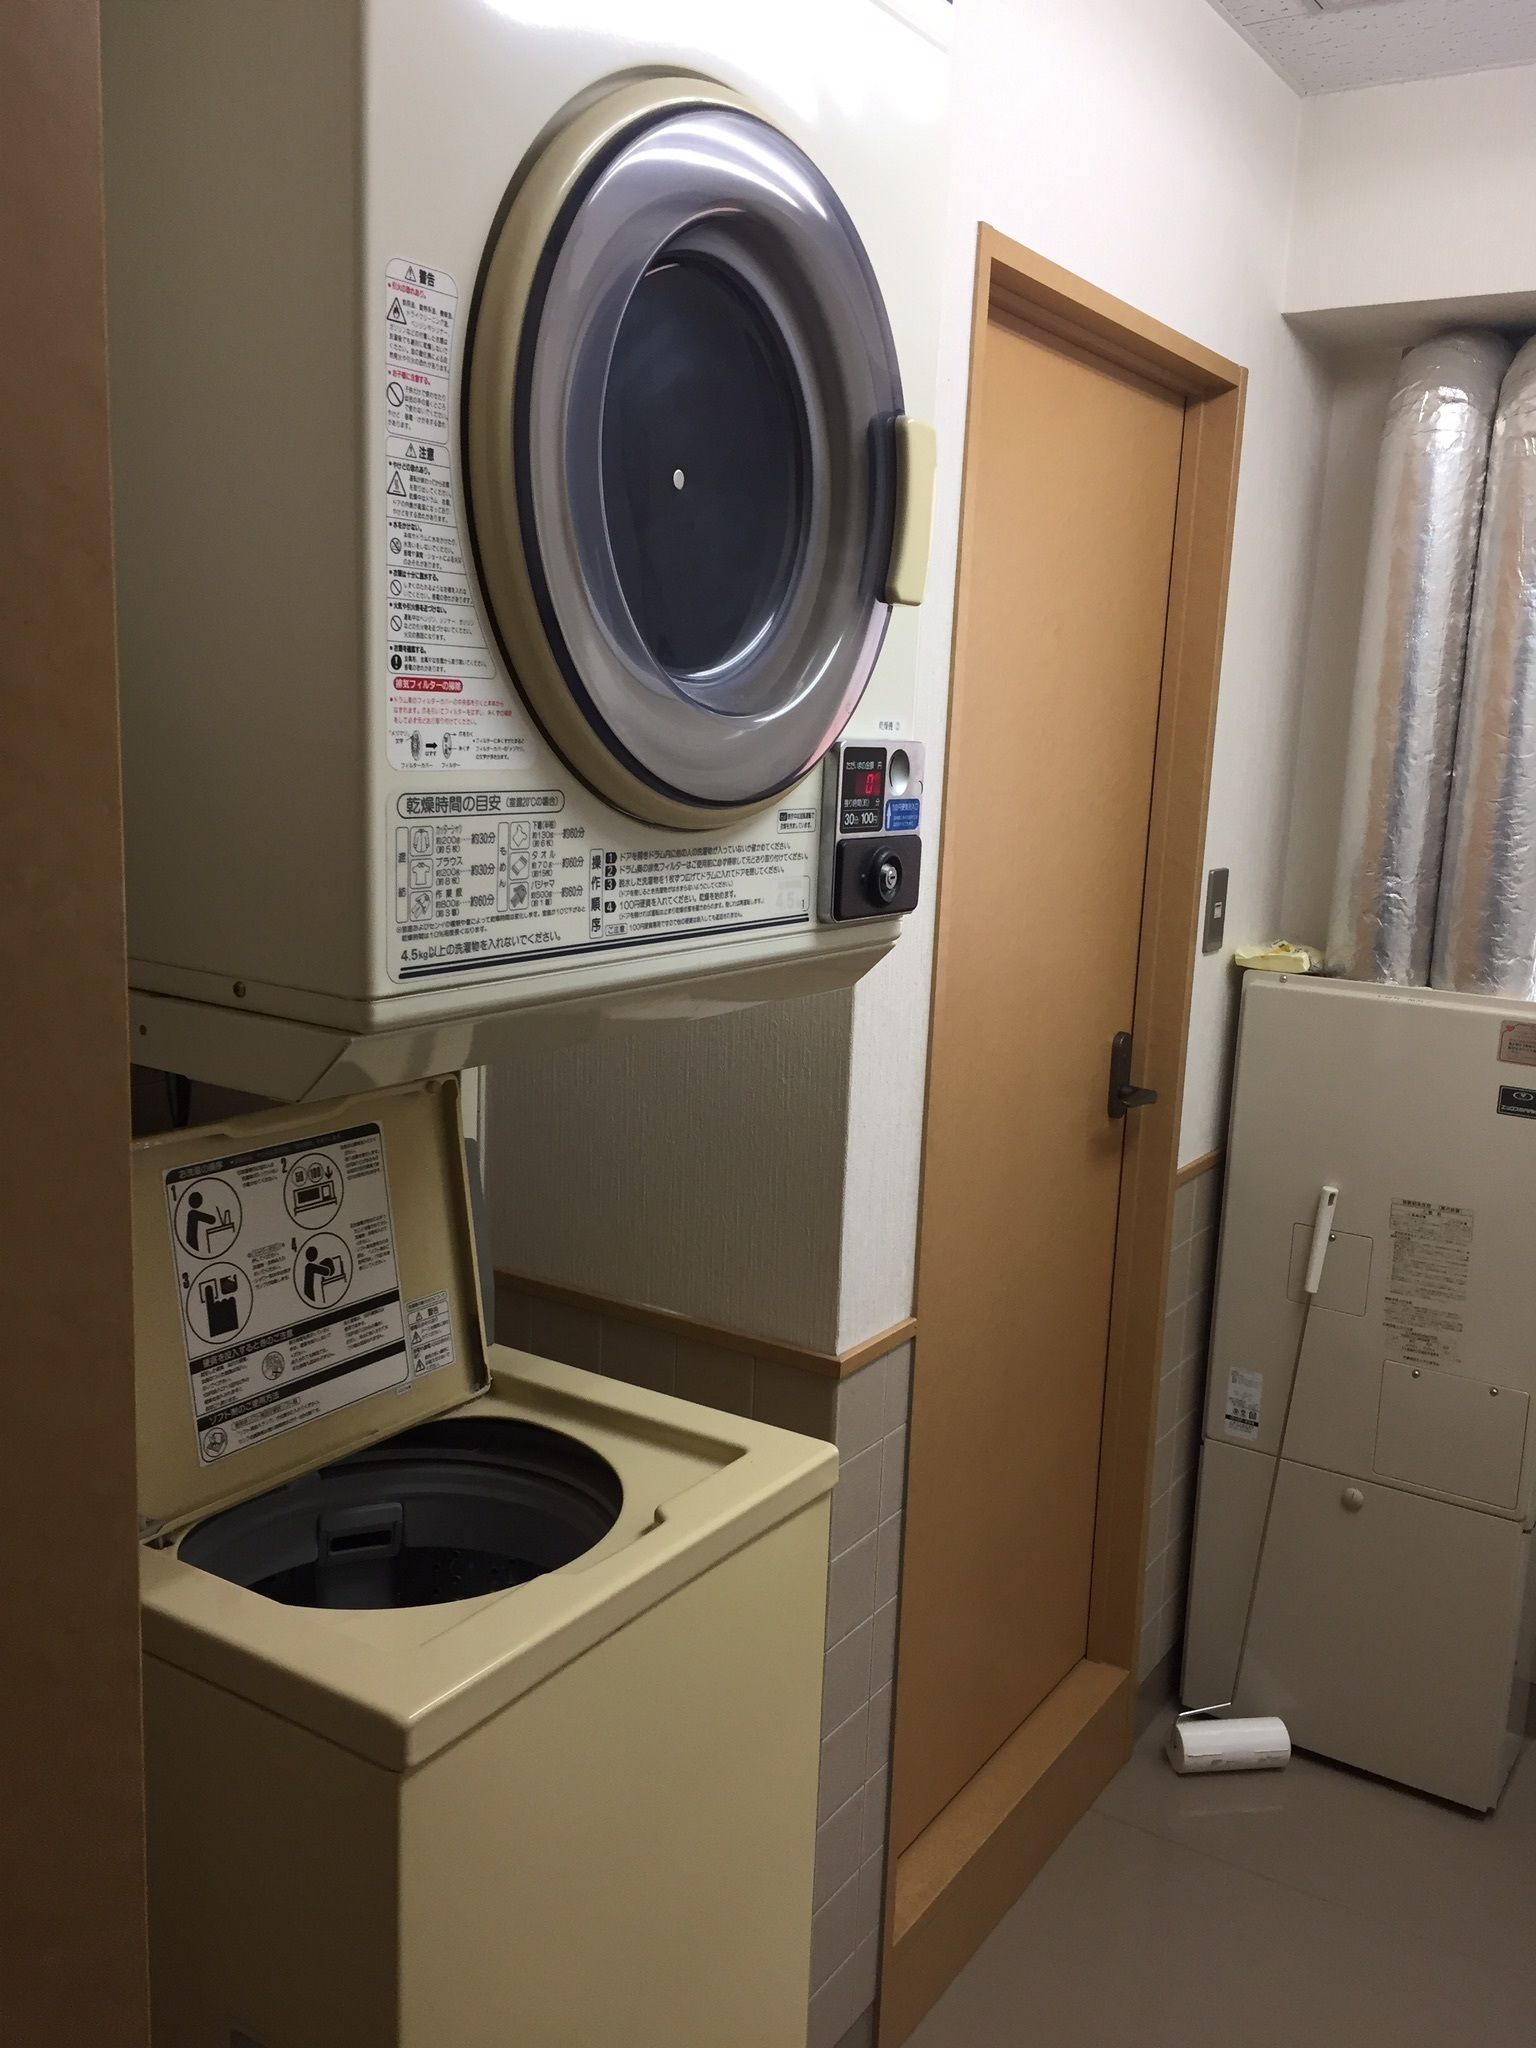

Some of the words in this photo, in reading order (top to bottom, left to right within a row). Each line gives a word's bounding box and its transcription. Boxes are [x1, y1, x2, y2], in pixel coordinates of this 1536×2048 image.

[419, 269, 435, 287] 警告
[418, 446, 435, 461] 注意
[406, 794, 501, 814] 乾燥時間の目安
[435, 856, 463, 867] ブラウス
[531, 851, 556, 860] タオル
[590, 854, 602, 933] 操作順序
[400, 930, 562, 961] 4.5kg以上の洗濯物を入れないでください。
[281, 1157, 288, 1174] 2
[182, 1272, 190, 1290] 3
